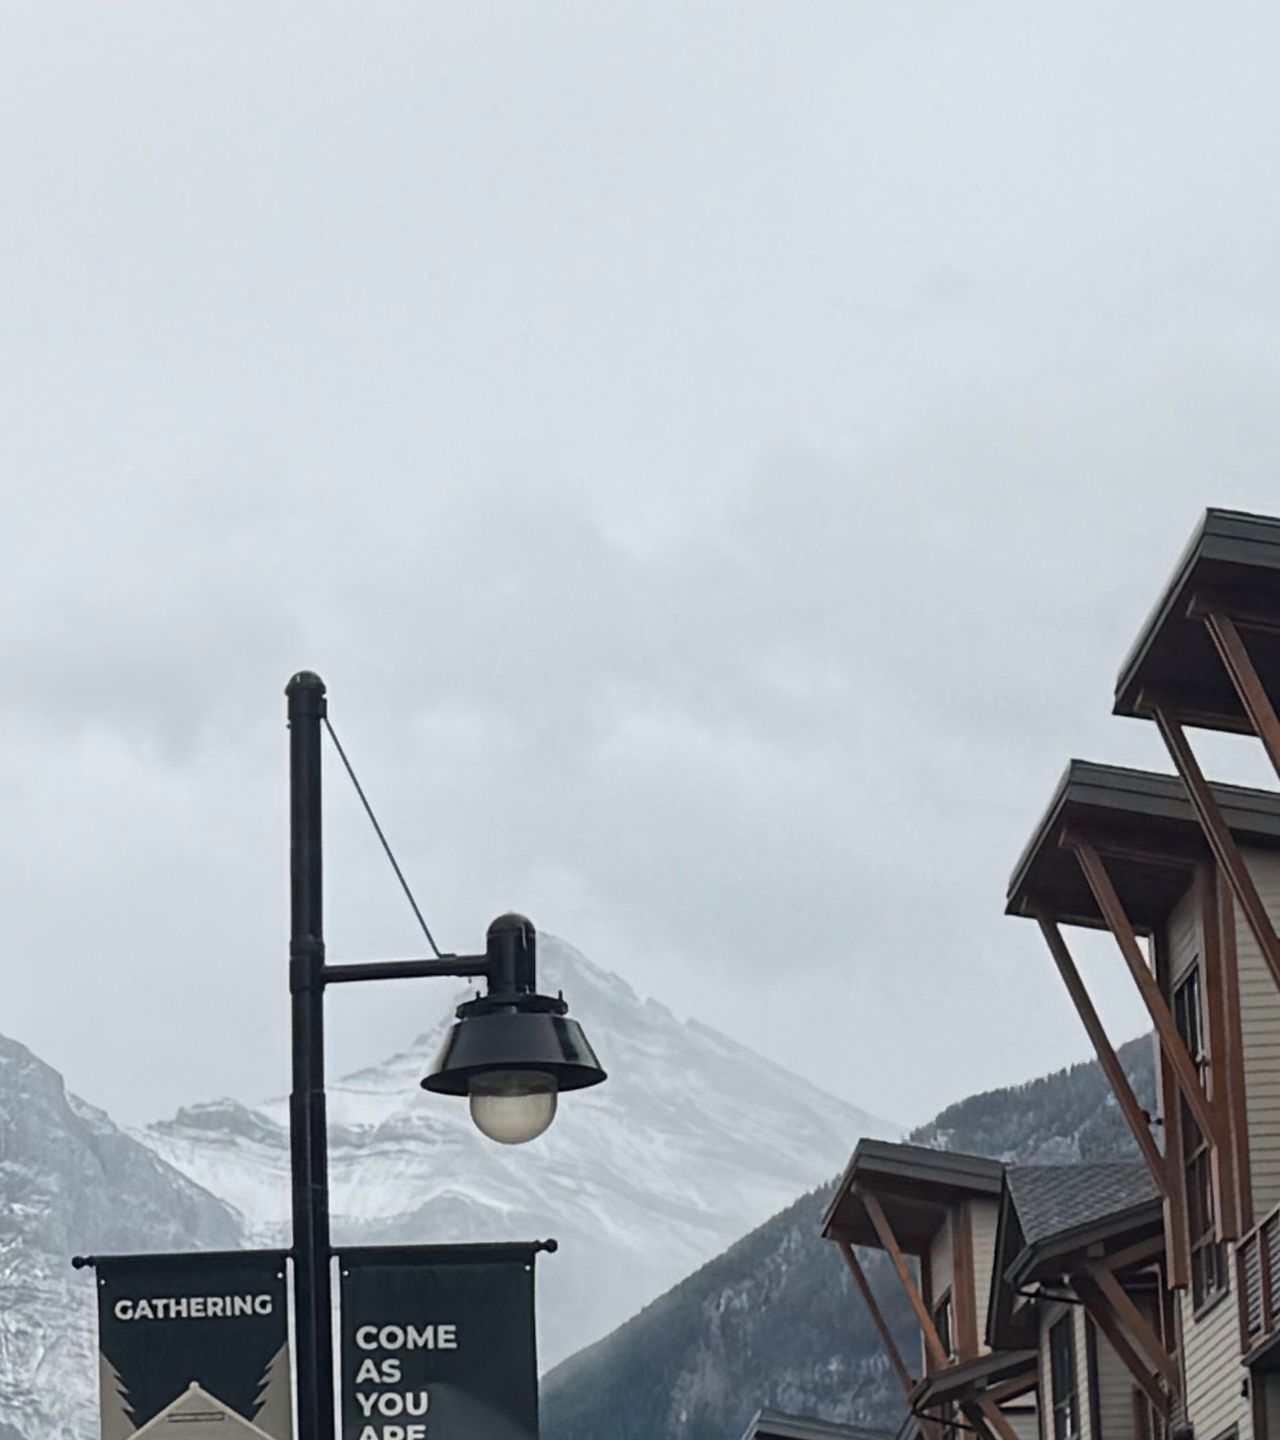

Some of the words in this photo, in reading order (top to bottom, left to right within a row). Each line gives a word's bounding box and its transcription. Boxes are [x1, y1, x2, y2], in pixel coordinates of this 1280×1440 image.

[114, 1295, 273, 1321] GATHERING
[355, 1325, 458, 1350] COME
[355, 1359, 401, 1384] AS
[356, 1392, 429, 1417] YOU
